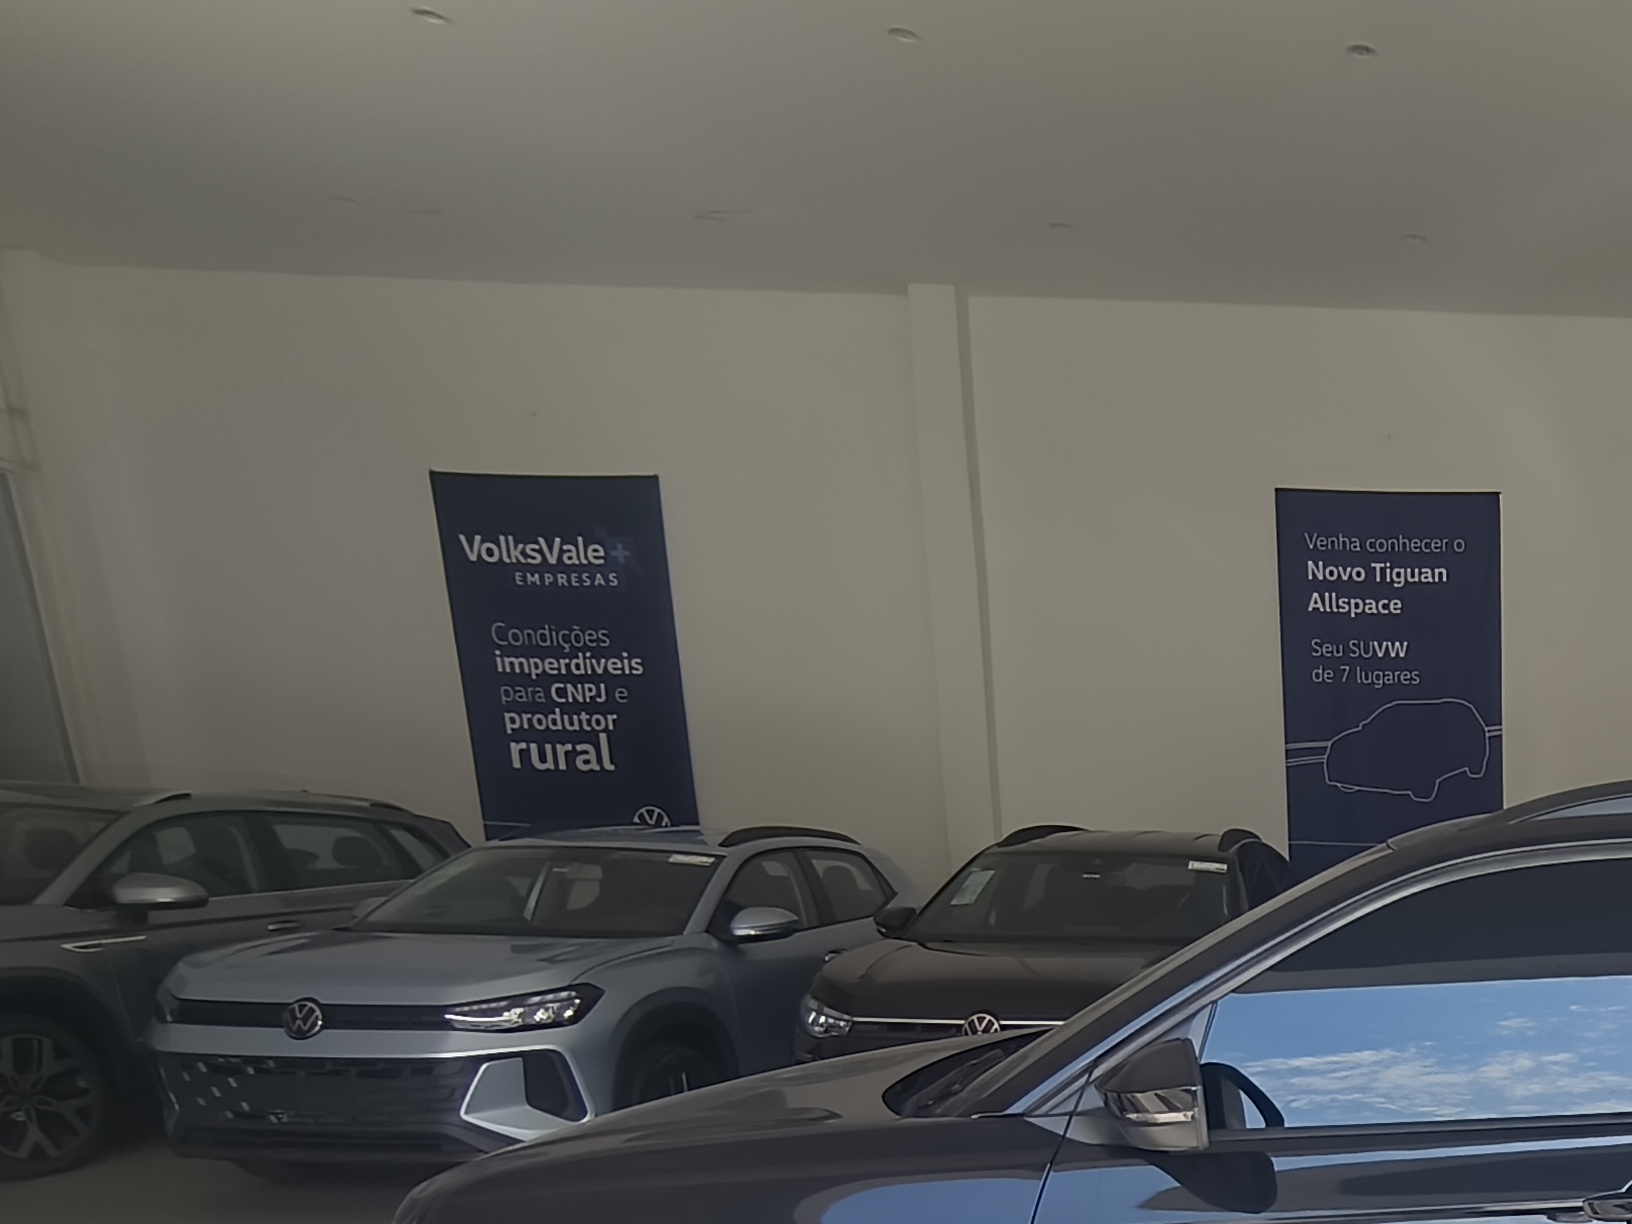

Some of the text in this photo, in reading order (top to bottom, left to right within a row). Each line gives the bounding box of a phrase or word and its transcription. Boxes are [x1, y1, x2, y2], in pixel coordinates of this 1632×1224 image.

[1303, 531, 1466, 553] Venha conhecer o
[514, 571, 619, 587] EMPRESAS
[1307, 560, 1448, 588] Novo Tiguan
[1307, 591, 1402, 618] Allspace
[491, 621, 611, 652] Condições
[1311, 638, 1408, 659] Seu SUVW
[495, 650, 644, 680] imperdíveis
[1311, 665, 1421, 689] de 7 lugares
[500, 682, 629, 706] para CNPJ e
[503, 708, 618, 735] produtor
[509, 732, 616, 772] rural
